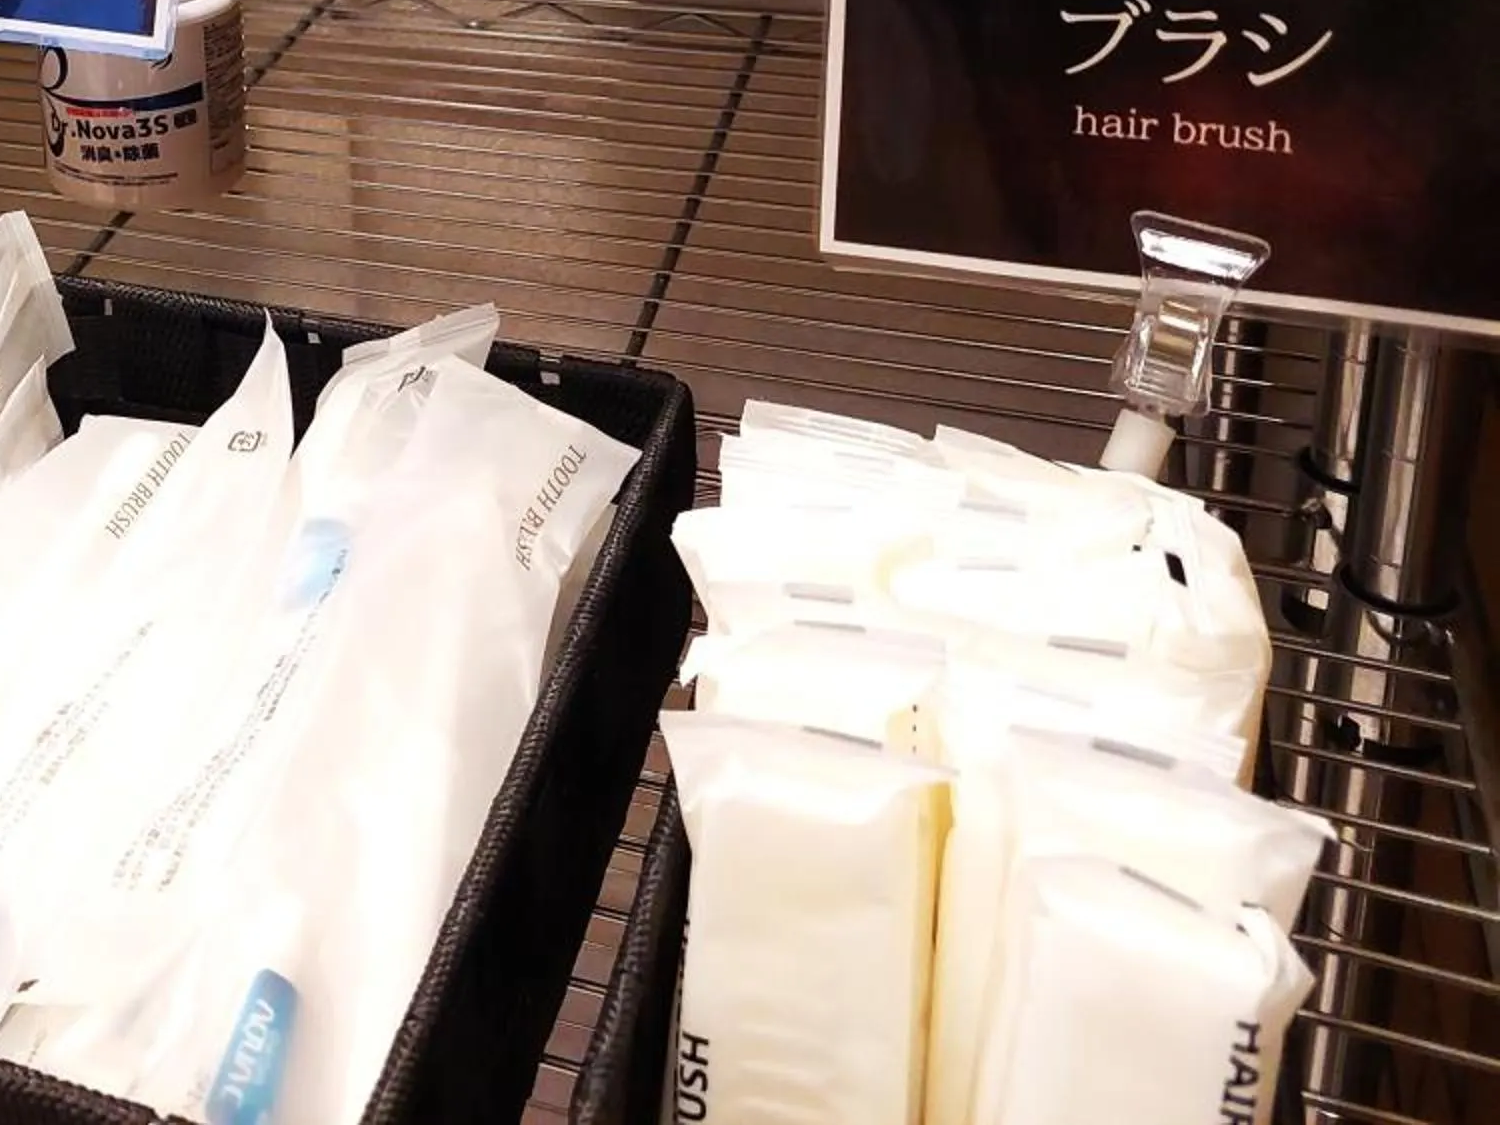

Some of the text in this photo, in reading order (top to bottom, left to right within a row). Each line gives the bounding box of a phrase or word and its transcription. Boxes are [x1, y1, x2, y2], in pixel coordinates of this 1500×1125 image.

[1072, 105, 1294, 154] hair brush
[536, 444, 587, 513] TOOTH
[104, 481, 154, 541] BRUSH
[675, 1030, 710, 1125] USH
